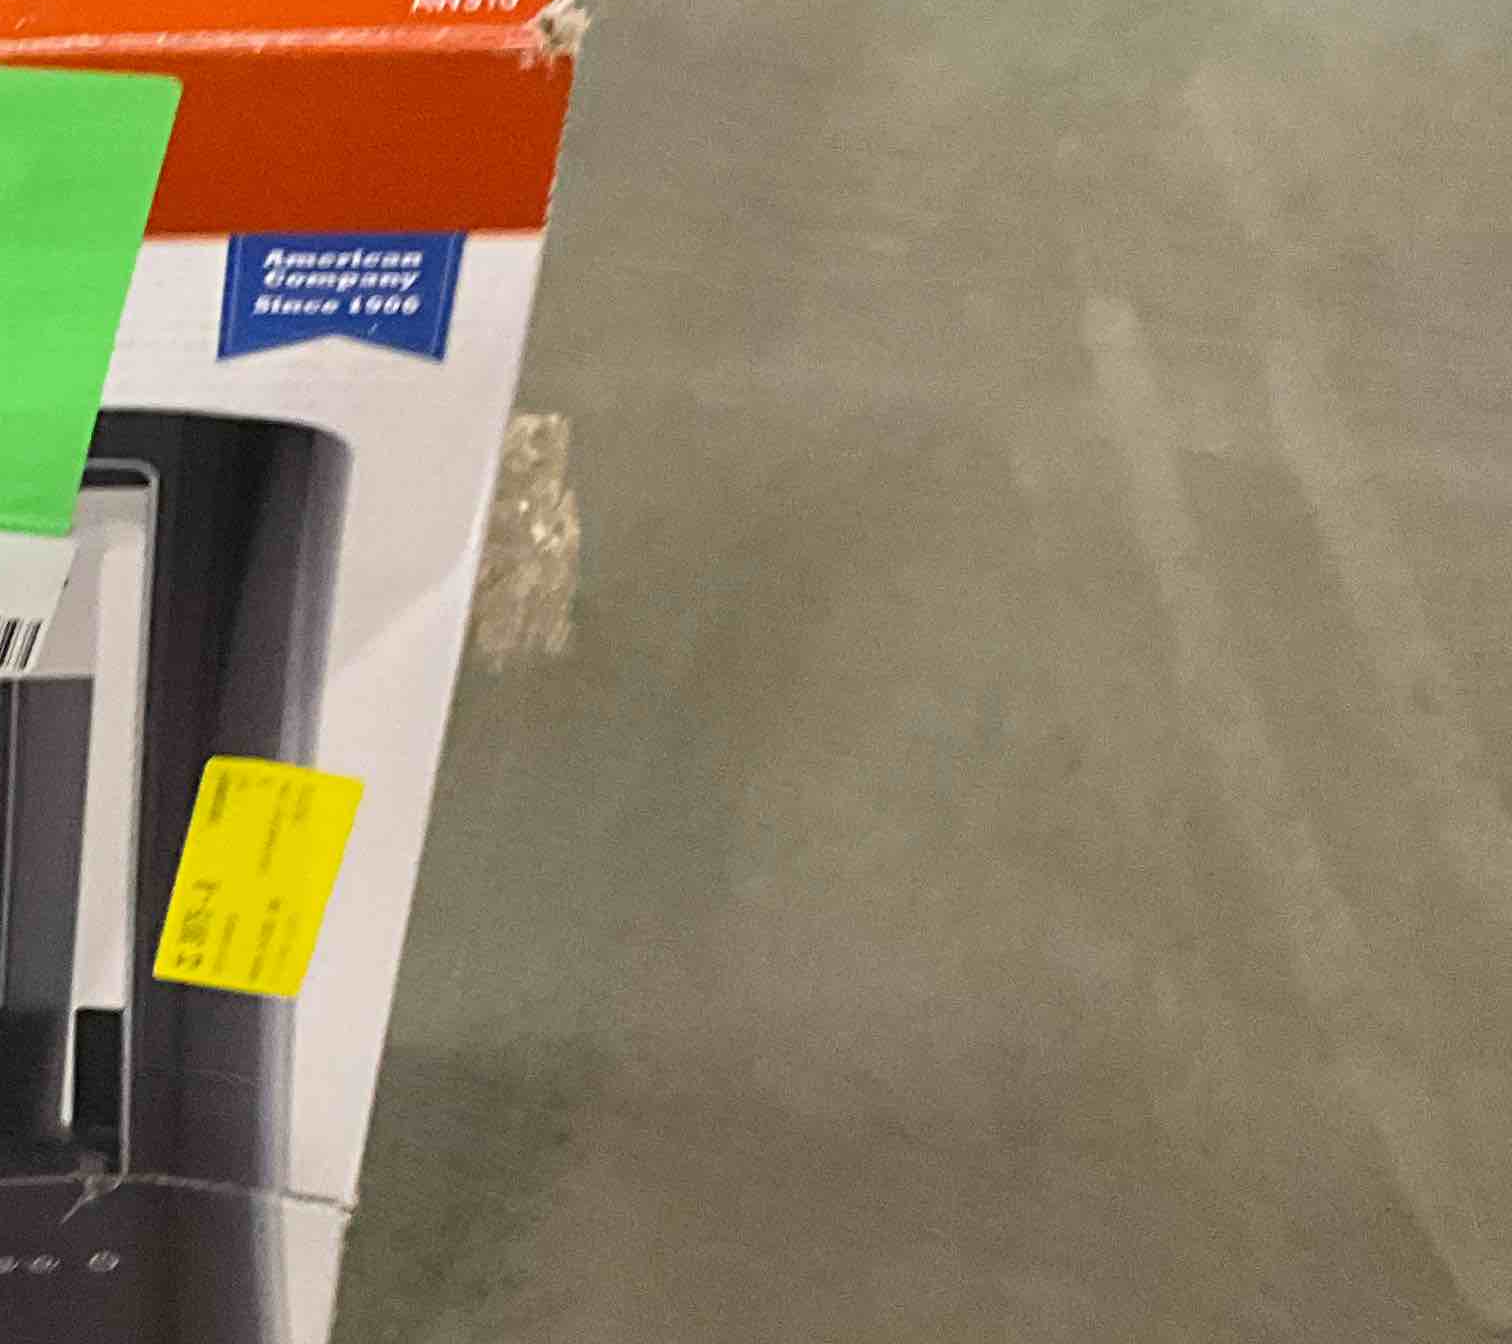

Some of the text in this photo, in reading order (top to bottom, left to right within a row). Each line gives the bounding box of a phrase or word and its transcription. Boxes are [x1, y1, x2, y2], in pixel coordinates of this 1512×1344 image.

[263, 248, 424, 270] American
[263, 271, 422, 293] Company
[252, 294, 341, 316] Since
